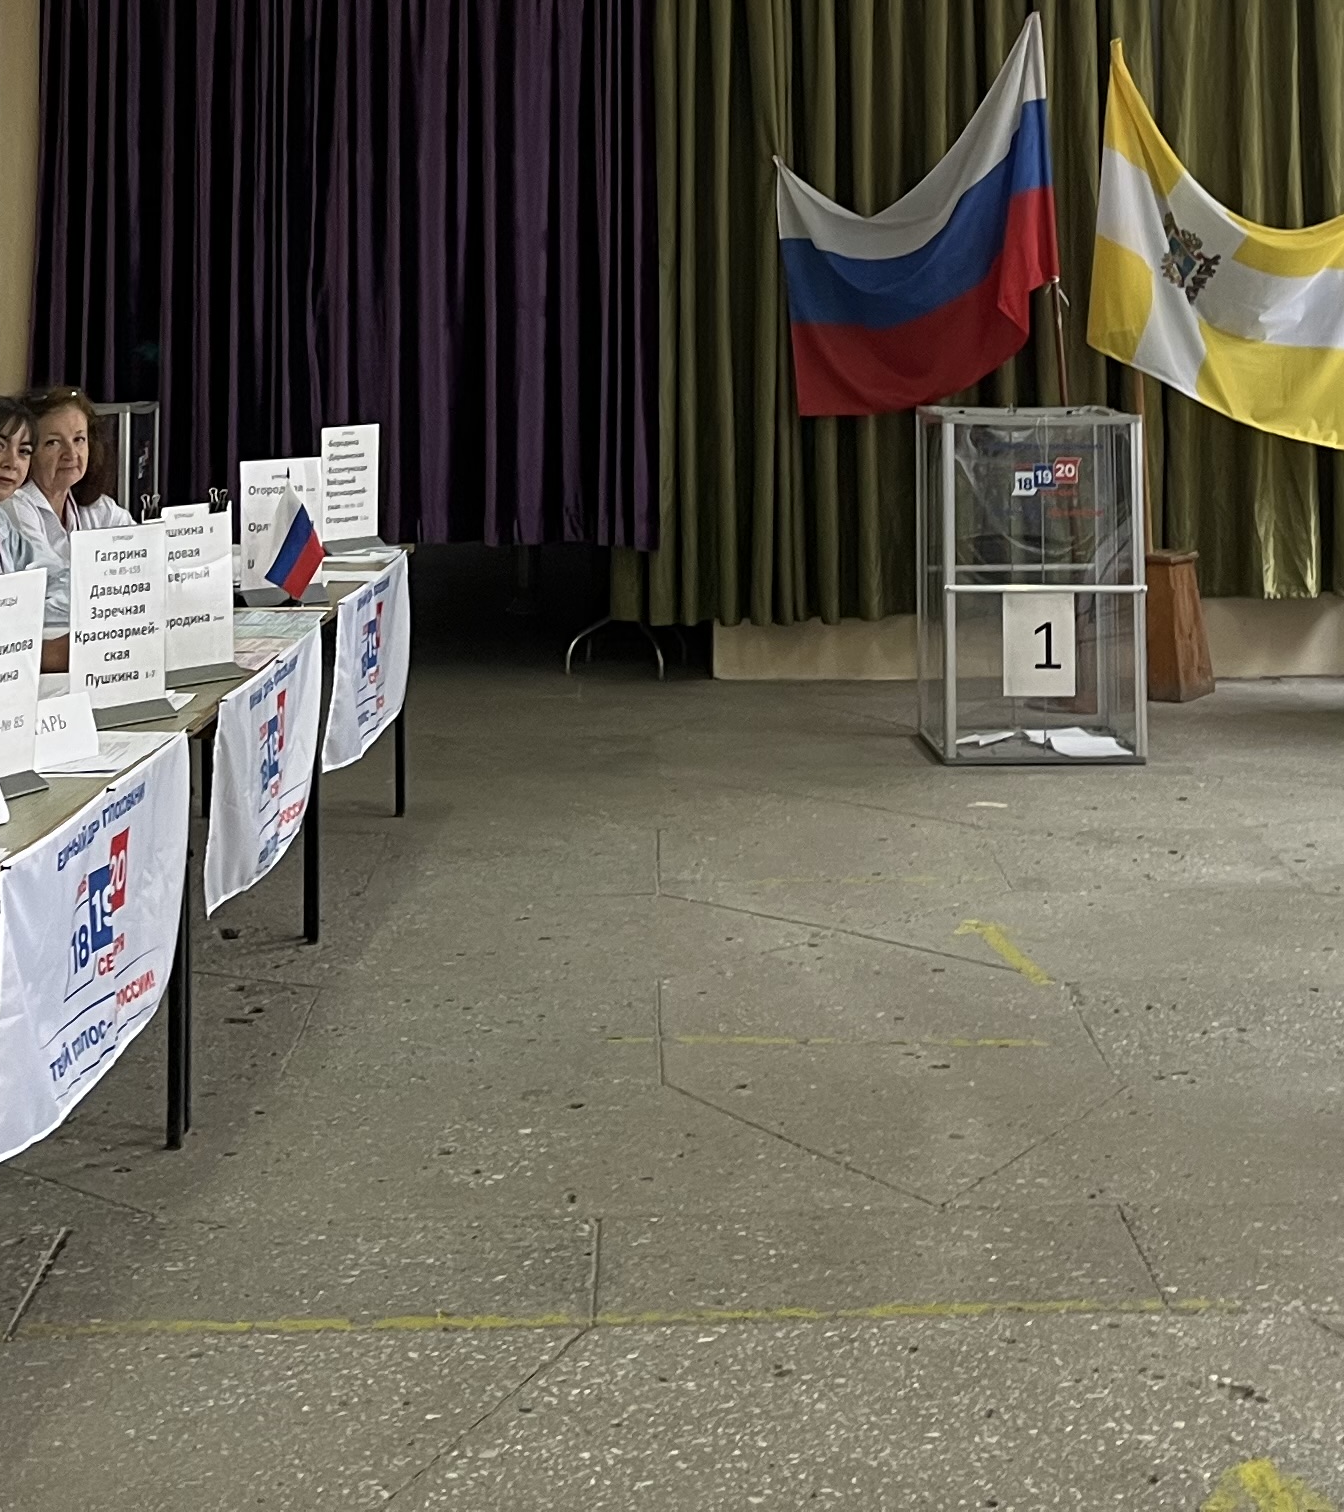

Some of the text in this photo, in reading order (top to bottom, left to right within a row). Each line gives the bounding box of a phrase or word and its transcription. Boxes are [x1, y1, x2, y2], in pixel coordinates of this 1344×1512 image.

[1017, 464, 1075, 491] 18 19 20
[166, 525, 204, 538] шкина
[94, 548, 147, 563] Гагарина
[167, 548, 200, 561] довая
[167, 567, 210, 584] верный
[89, 581, 151, 599] Давыдова
[90, 603, 146, 620] Заречная
[166, 613, 211, 630] родина
[74, 622, 159, 645] Красноармей-
[1034, 621, 1062, 670] 1
[104, 649, 130, 662] ская
[85, 670, 139, 688] Пушкина
[35, 713, 67, 735] АРЬ
[72, 924, 89, 975] 18
